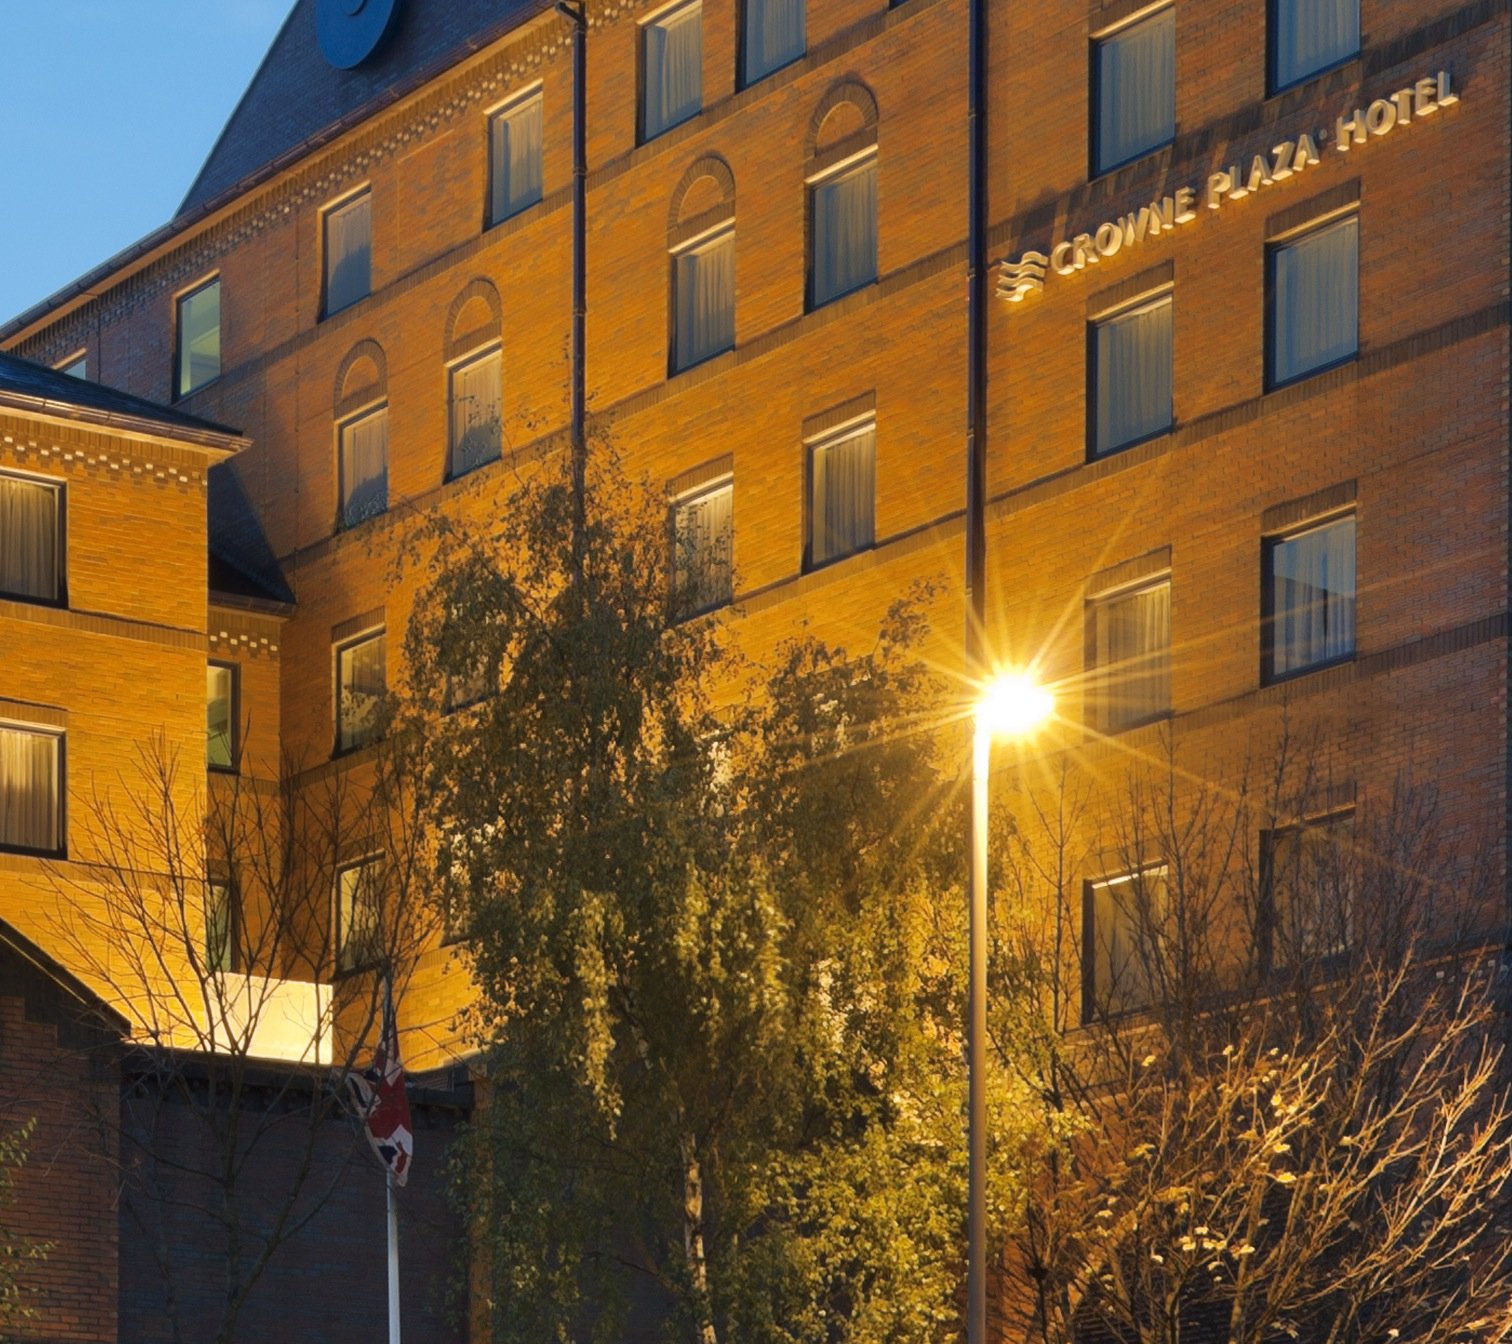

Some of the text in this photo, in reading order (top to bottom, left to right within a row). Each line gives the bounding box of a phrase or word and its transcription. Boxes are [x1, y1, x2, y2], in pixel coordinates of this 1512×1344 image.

[1050, 71, 1459, 275] CROWNE PLAZA HOTEL
